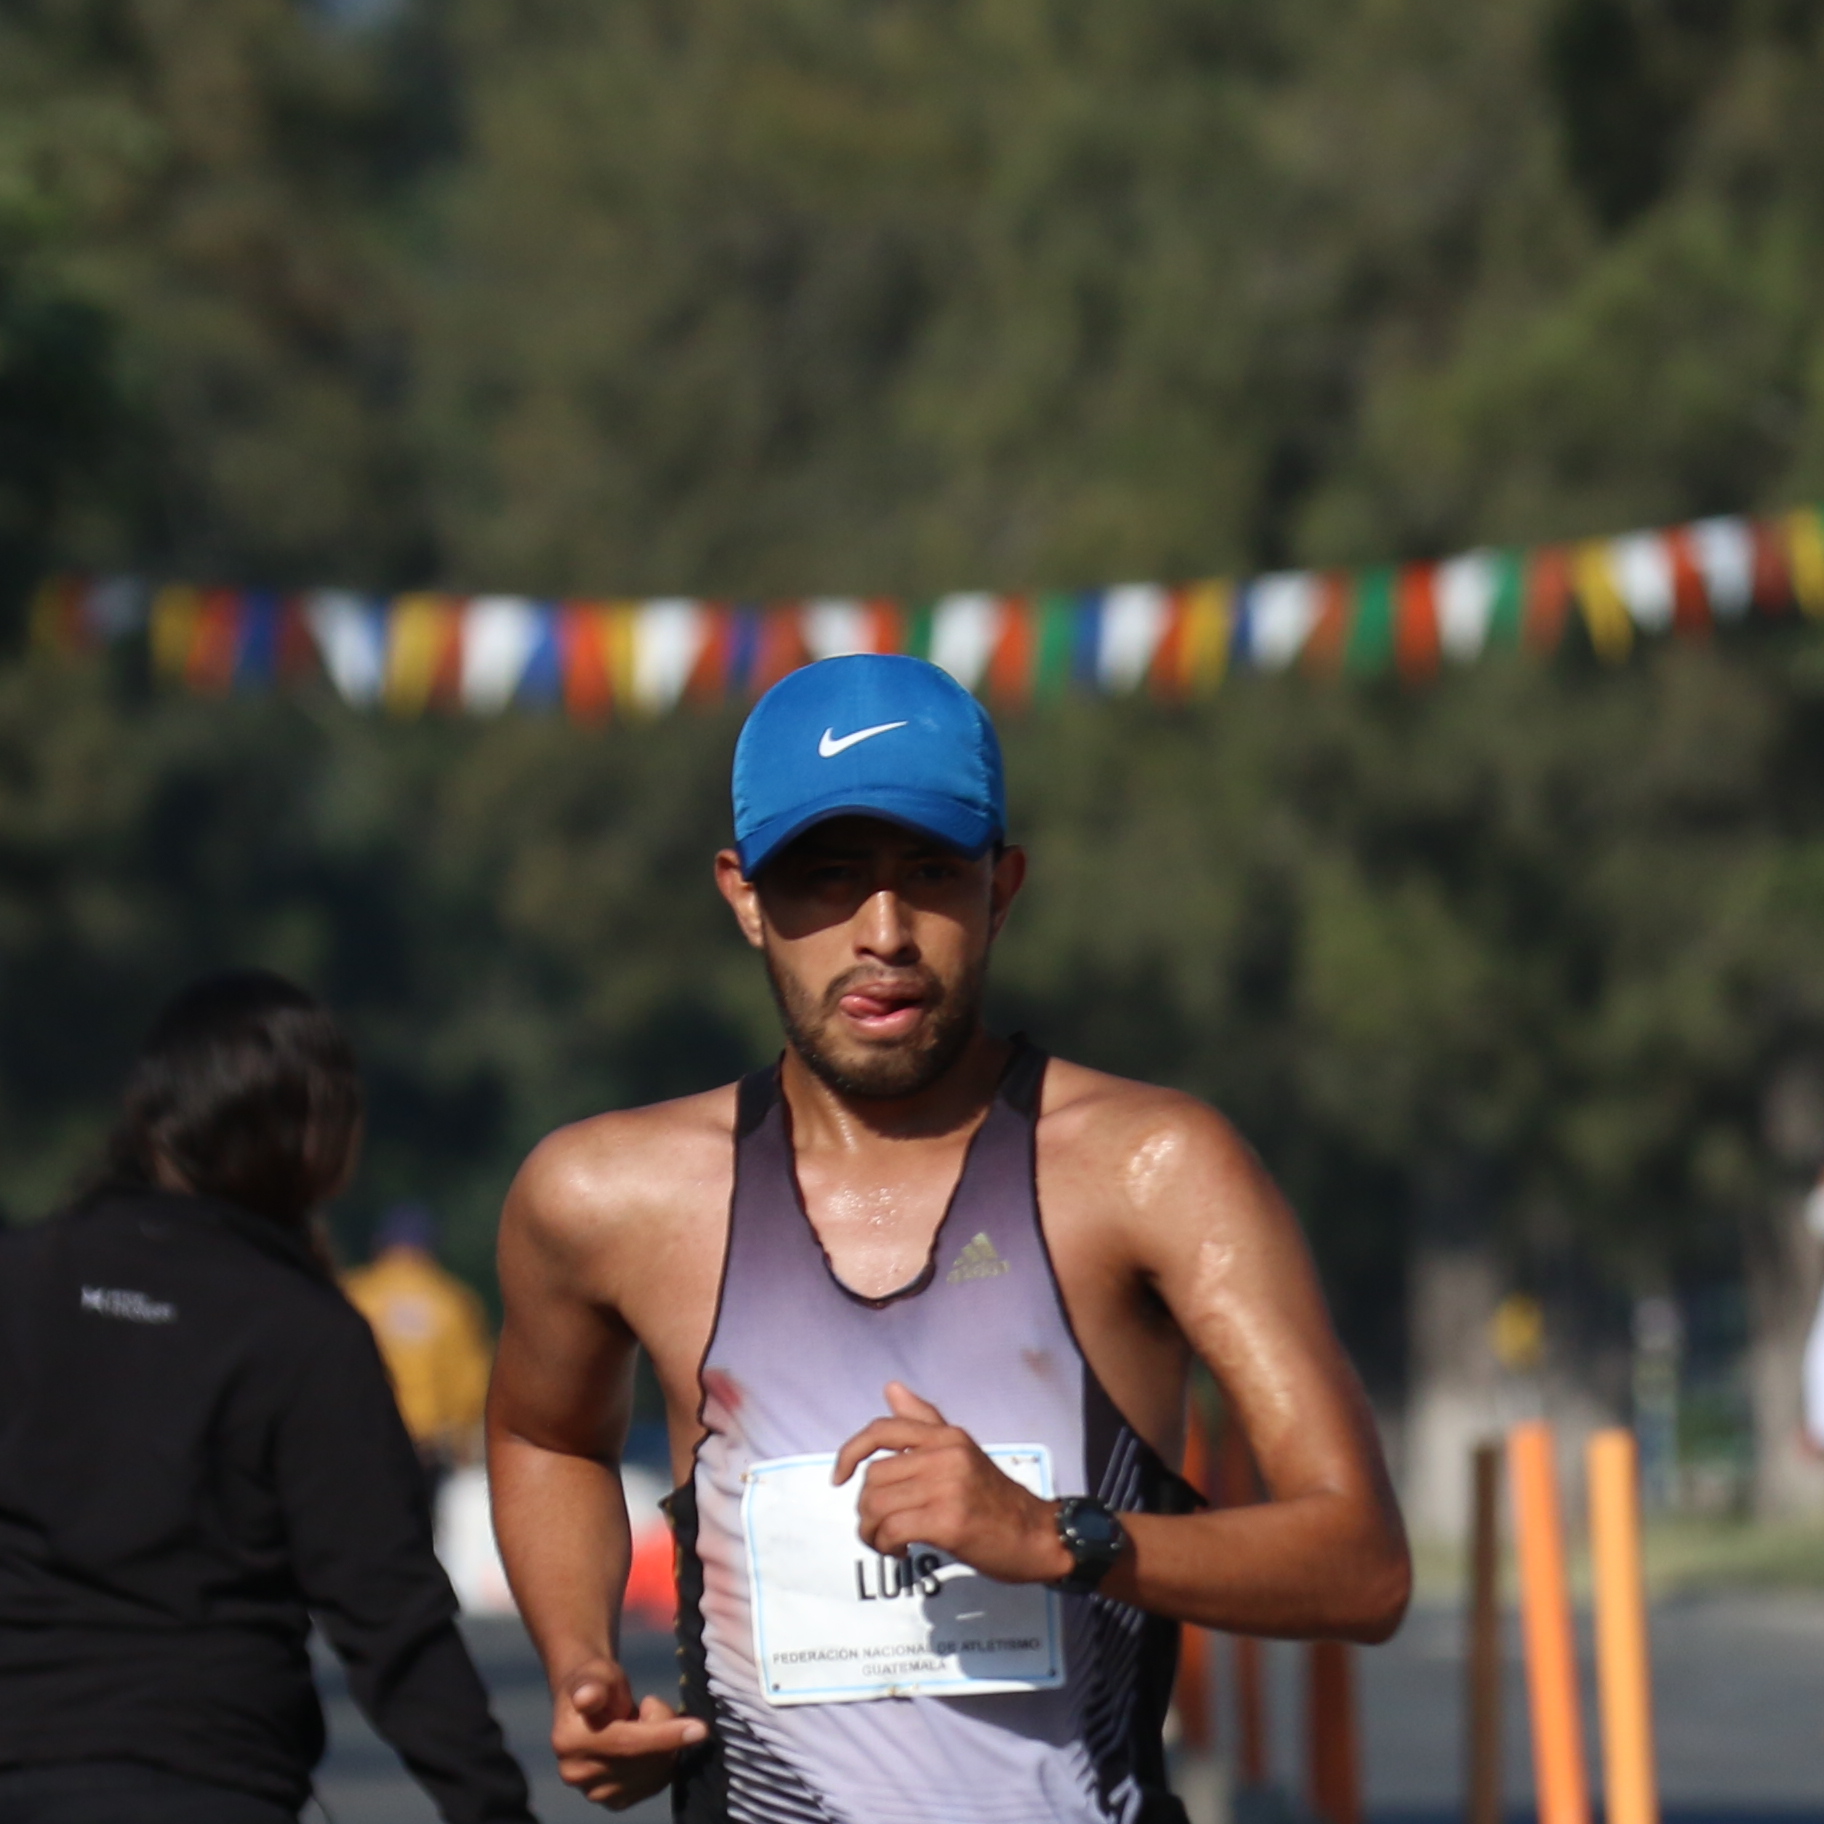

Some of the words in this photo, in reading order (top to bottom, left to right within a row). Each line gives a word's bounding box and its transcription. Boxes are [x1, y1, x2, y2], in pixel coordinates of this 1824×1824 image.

[855, 1554, 941, 1600] LUIS
[772, 1645, 859, 1664] FEDERACIÓN
[961, 1637, 1042, 1652] ATLETISMO
[862, 1660, 946, 1677] GUATEMALA
